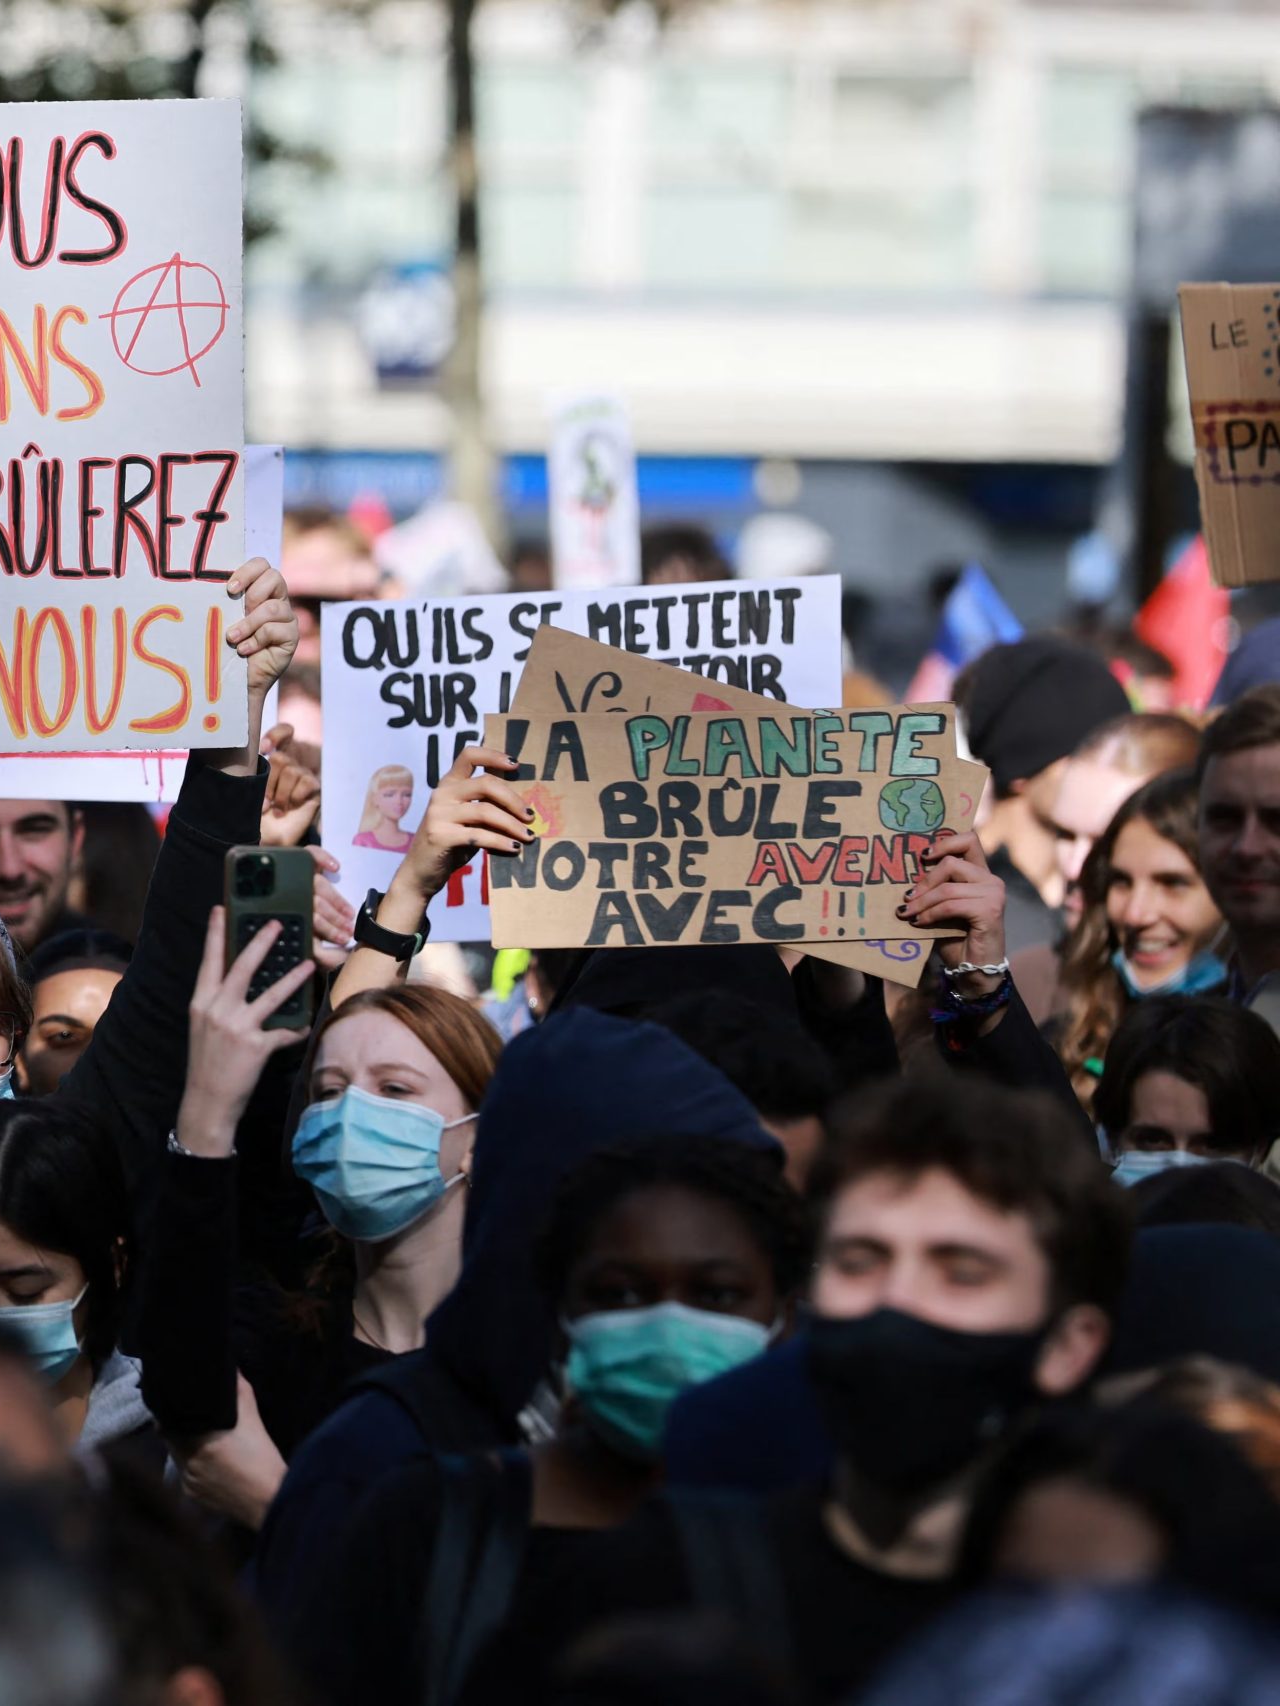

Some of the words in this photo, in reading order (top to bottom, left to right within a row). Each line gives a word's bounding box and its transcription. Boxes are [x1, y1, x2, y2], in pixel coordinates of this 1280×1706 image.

[1210, 319, 1248, 350] LE
[342, 603, 494, 670] QU'ILS
[587, 588, 802, 653] METTENT
[380, 672, 477, 728] SUR
[503, 719, 589, 782] LA
[599, 777, 862, 839] BRÛLE
[488, 837, 709, 891] NOTRE
